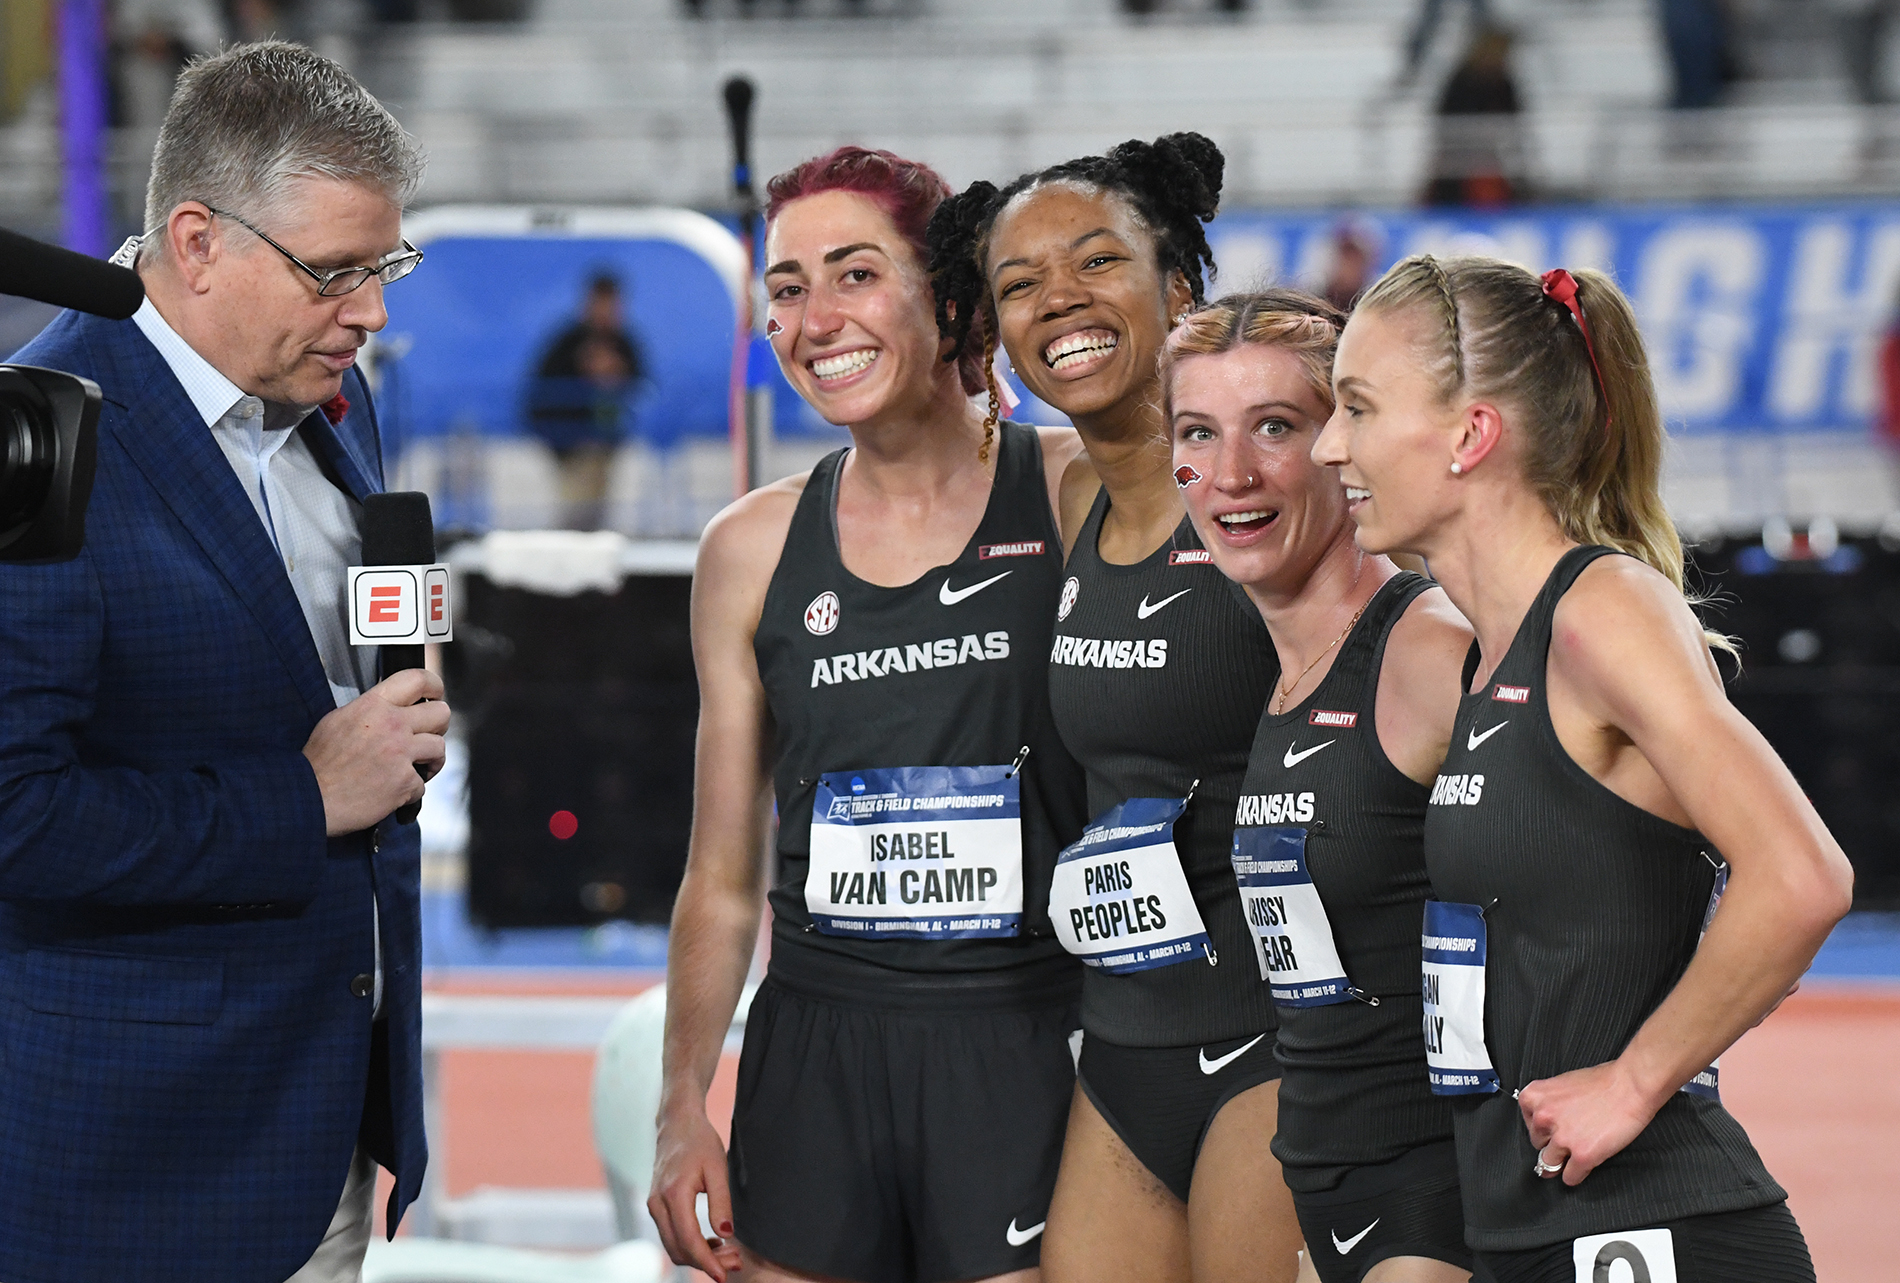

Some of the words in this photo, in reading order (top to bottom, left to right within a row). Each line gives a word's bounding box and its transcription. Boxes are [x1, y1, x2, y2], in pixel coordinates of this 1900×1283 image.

[988, 543, 1042, 556] EQUALITY
[1175, 551, 1214, 563] EQUALIT
[807, 594, 839, 633] SEC
[810, 630, 1010, 688] ARKANSAS
[1050, 635, 1167, 668] ARKANSAS
[1314, 711, 1356, 725] EQUALITY
[851, 800, 876, 814] TRACK
[884, 798, 911, 811] FIELD
[912, 794, 1005, 810] CHAMPIONSHIPS
[870, 831, 955, 862] ISABEL
[830, 871, 887, 905] VAN
[899, 867, 998, 904] CAMP
[1084, 860, 1133, 896] PARIS
[831, 919, 864, 930] DIVISION
[875, 920, 930, 932] BIRMINGHAM,
[932, 921, 942, 931] AL
[950, 919, 980, 930] MARCH
[981, 918, 1002, 929] 11-12
[1069, 894, 1167, 943] PEOPLES
[1248, 895, 1288, 927] RISSY
[1137, 951, 1145, 962] AL
[1149, 945, 1174, 960] MARCH
[1174, 942, 1191, 954] 11-12
[1260, 935, 1299, 972] EAR
[1302, 986, 1323, 998] MARCH
